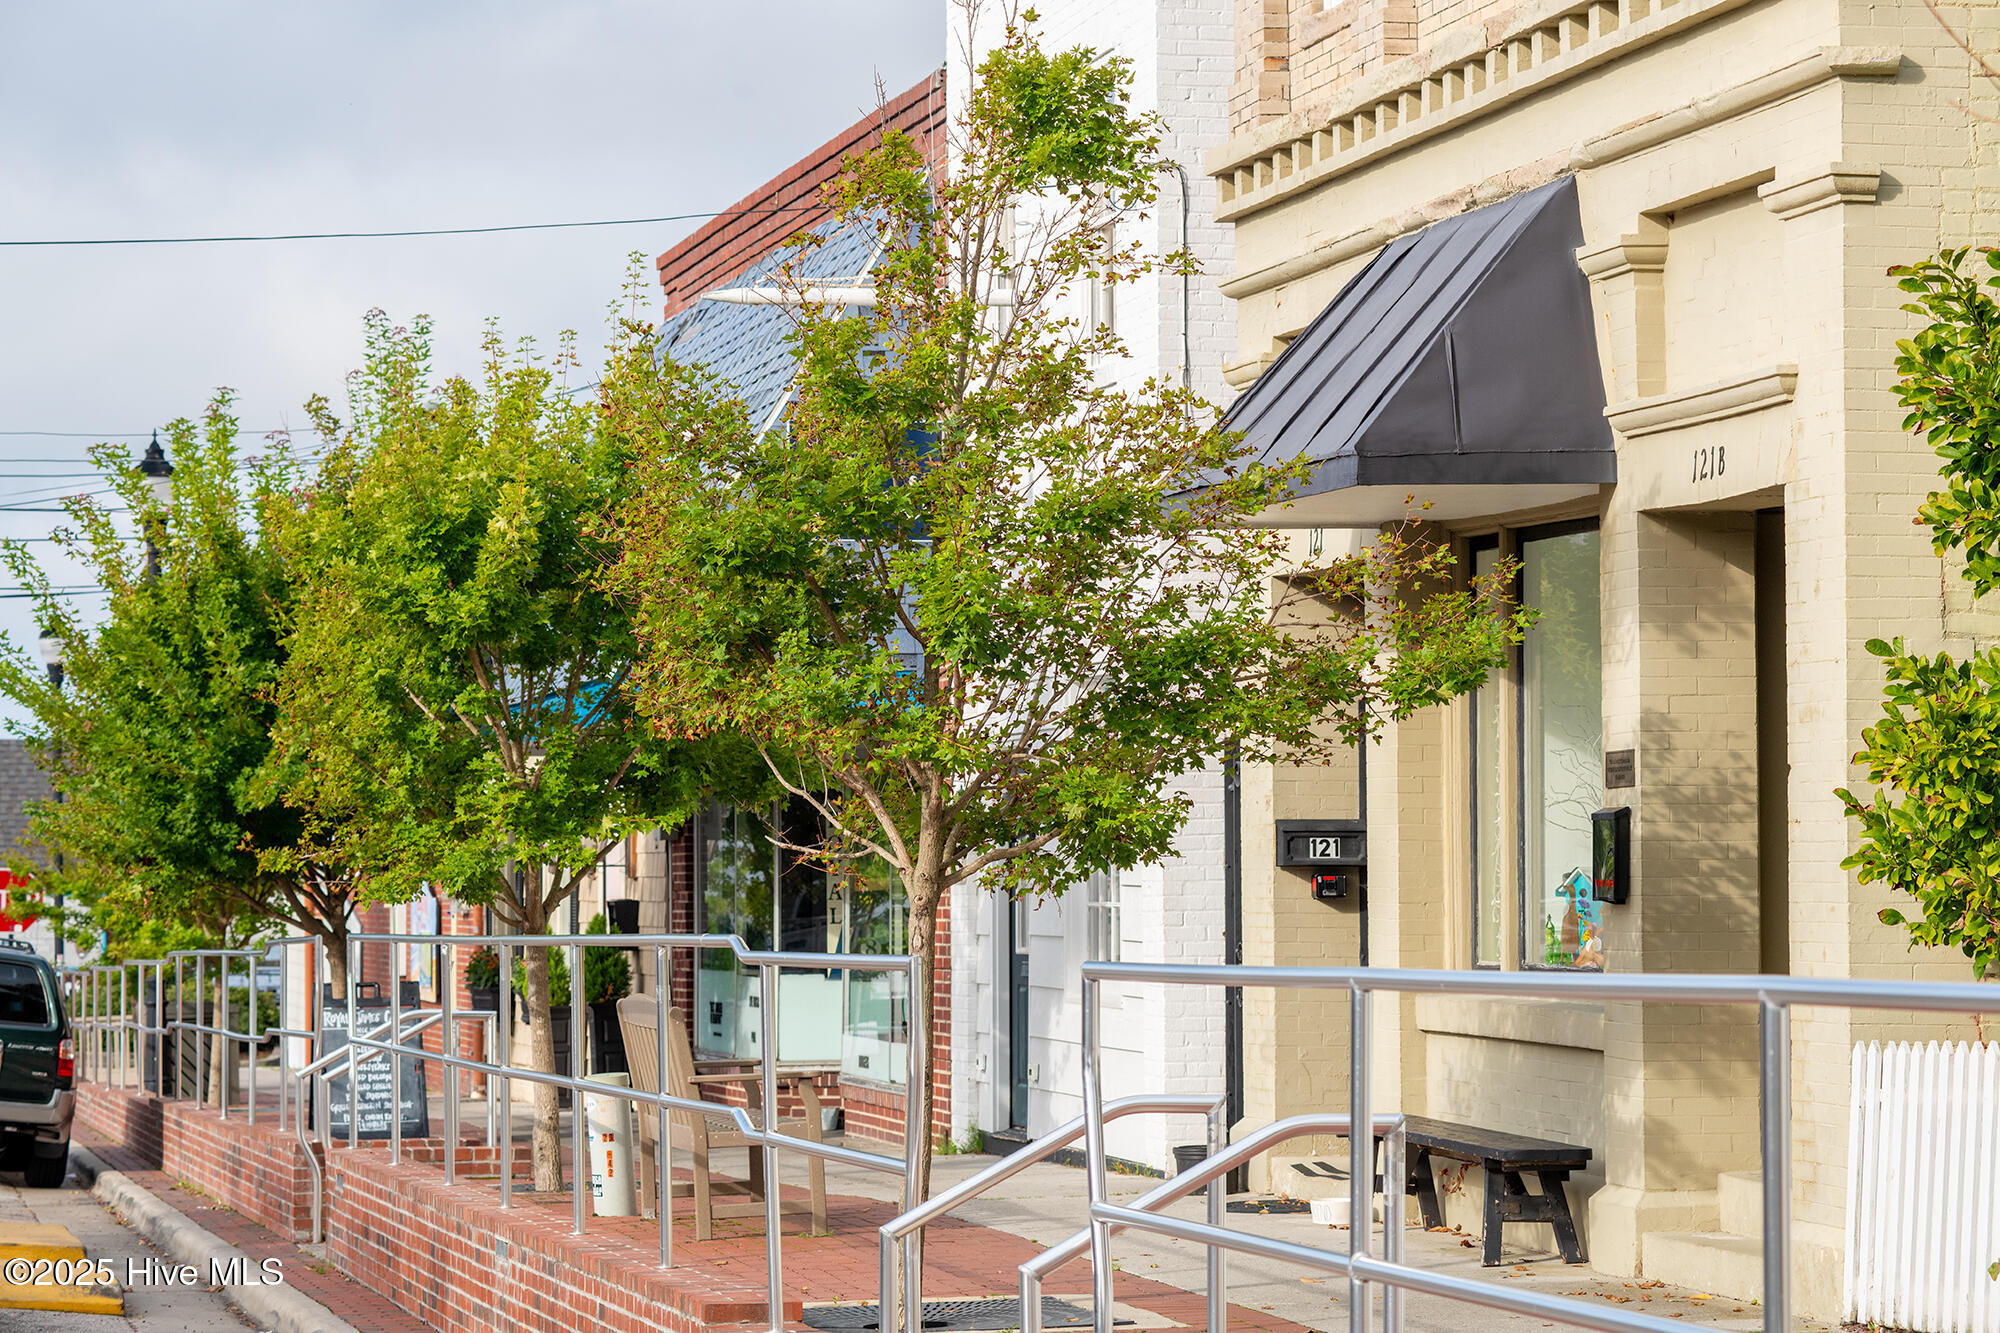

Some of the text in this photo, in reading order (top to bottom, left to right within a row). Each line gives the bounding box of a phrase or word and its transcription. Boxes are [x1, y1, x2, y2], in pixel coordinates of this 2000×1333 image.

[1692, 445, 1725, 483] 121B
[1309, 528, 1323, 556] 121
[1310, 838, 1340, 857] 121
